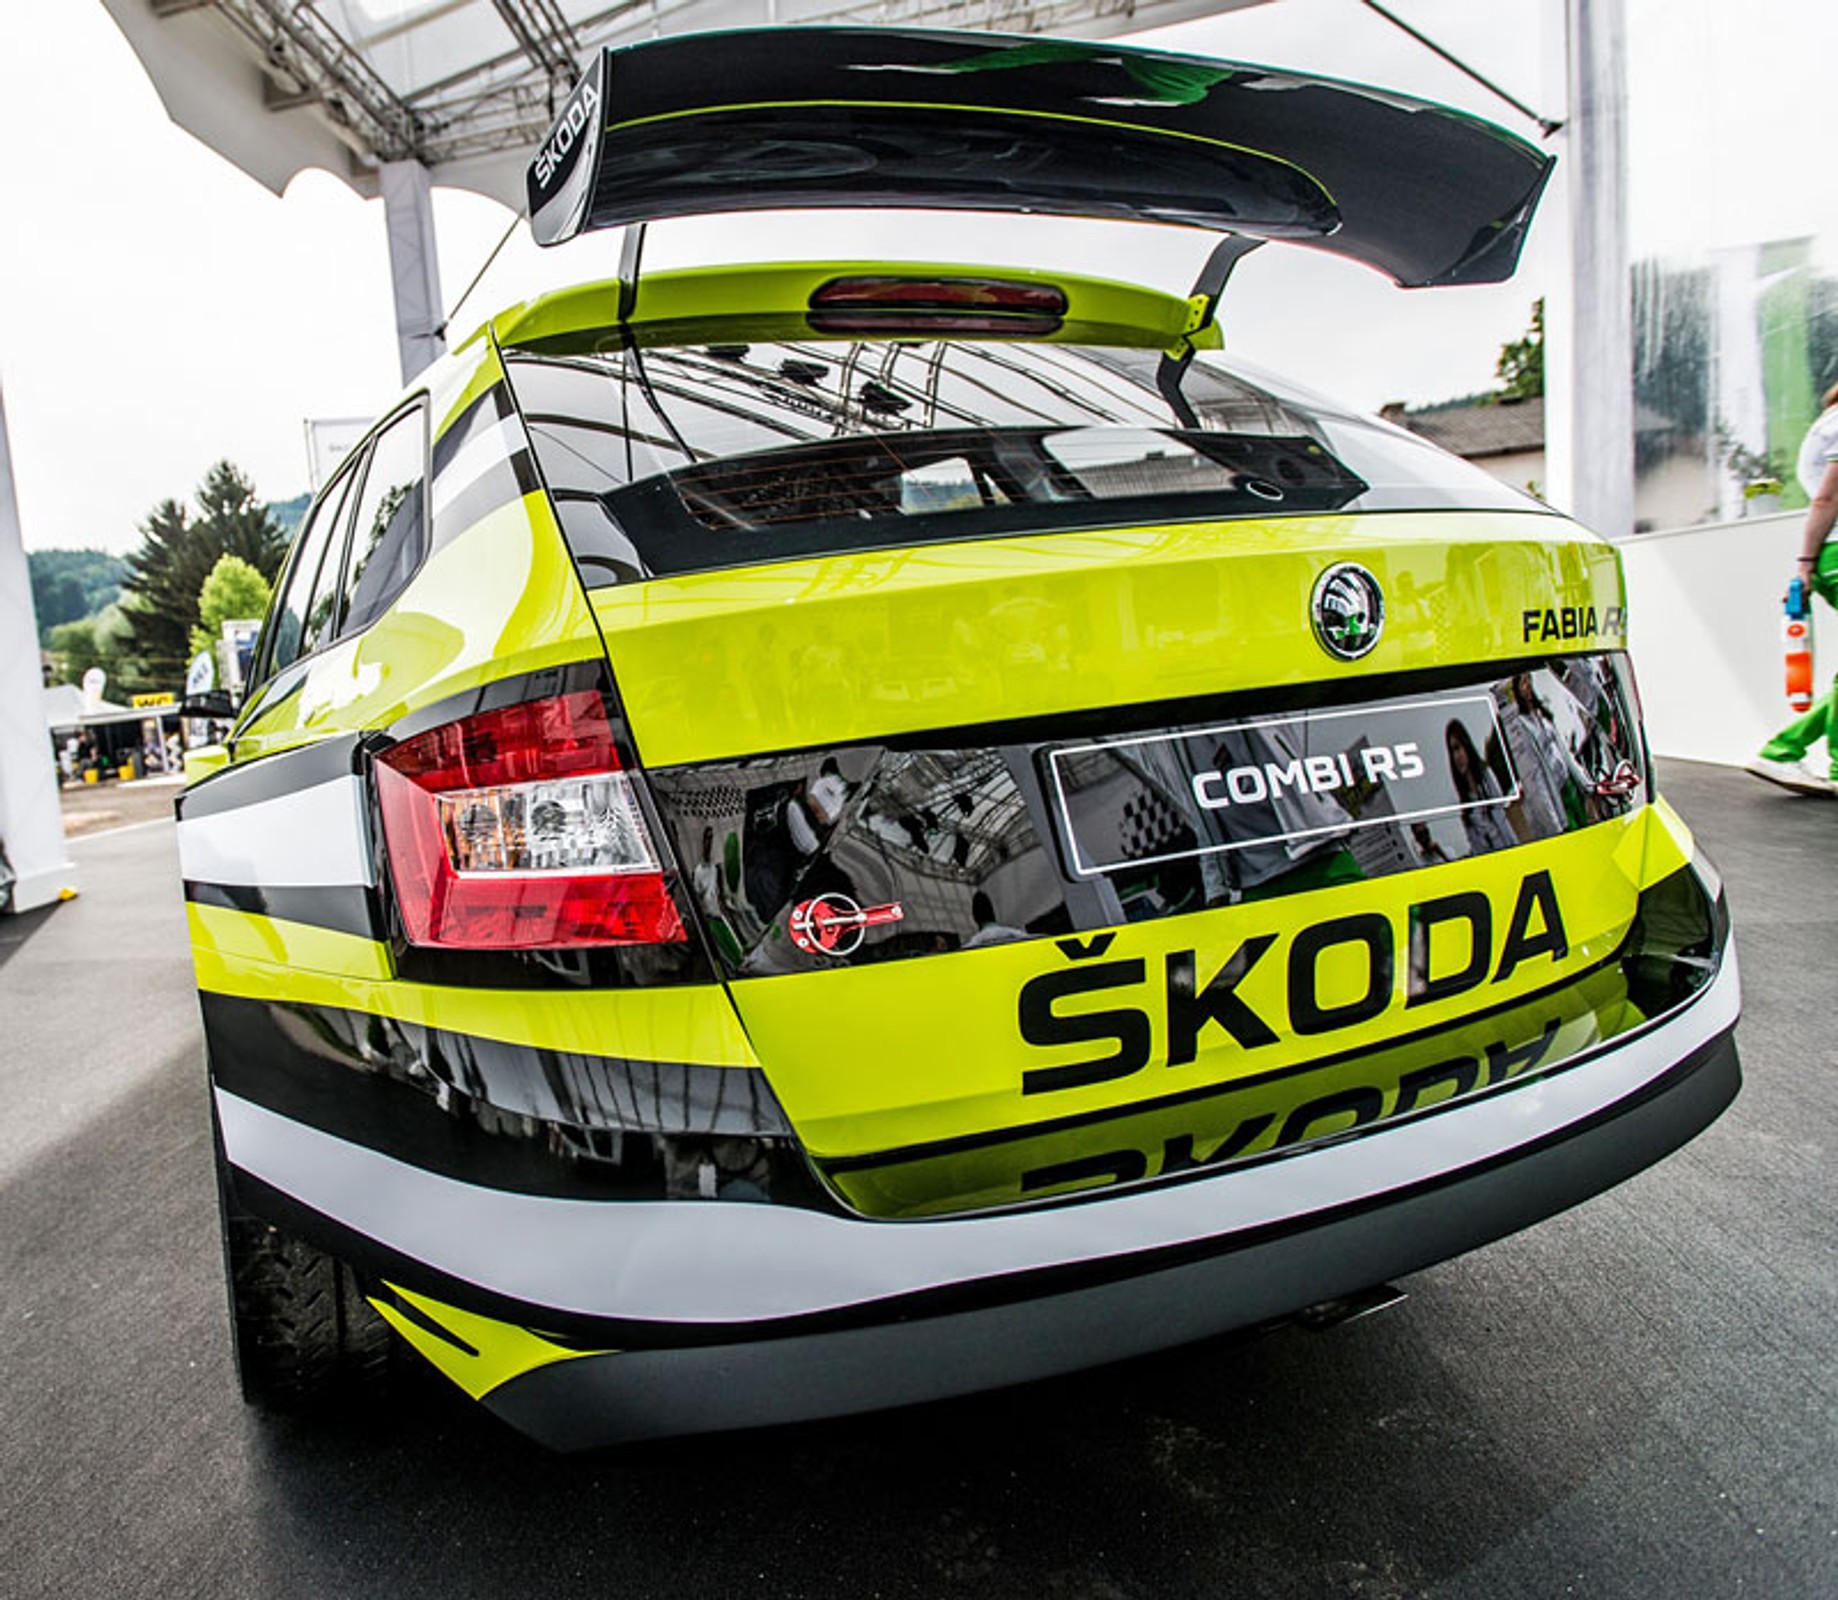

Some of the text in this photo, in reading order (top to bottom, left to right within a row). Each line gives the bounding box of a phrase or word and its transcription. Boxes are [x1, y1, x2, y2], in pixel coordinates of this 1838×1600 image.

[1523, 606, 1598, 643] FABIA
[1192, 742, 1425, 810] COMBI R5
[1017, 869, 1570, 1096] ŠKODA
